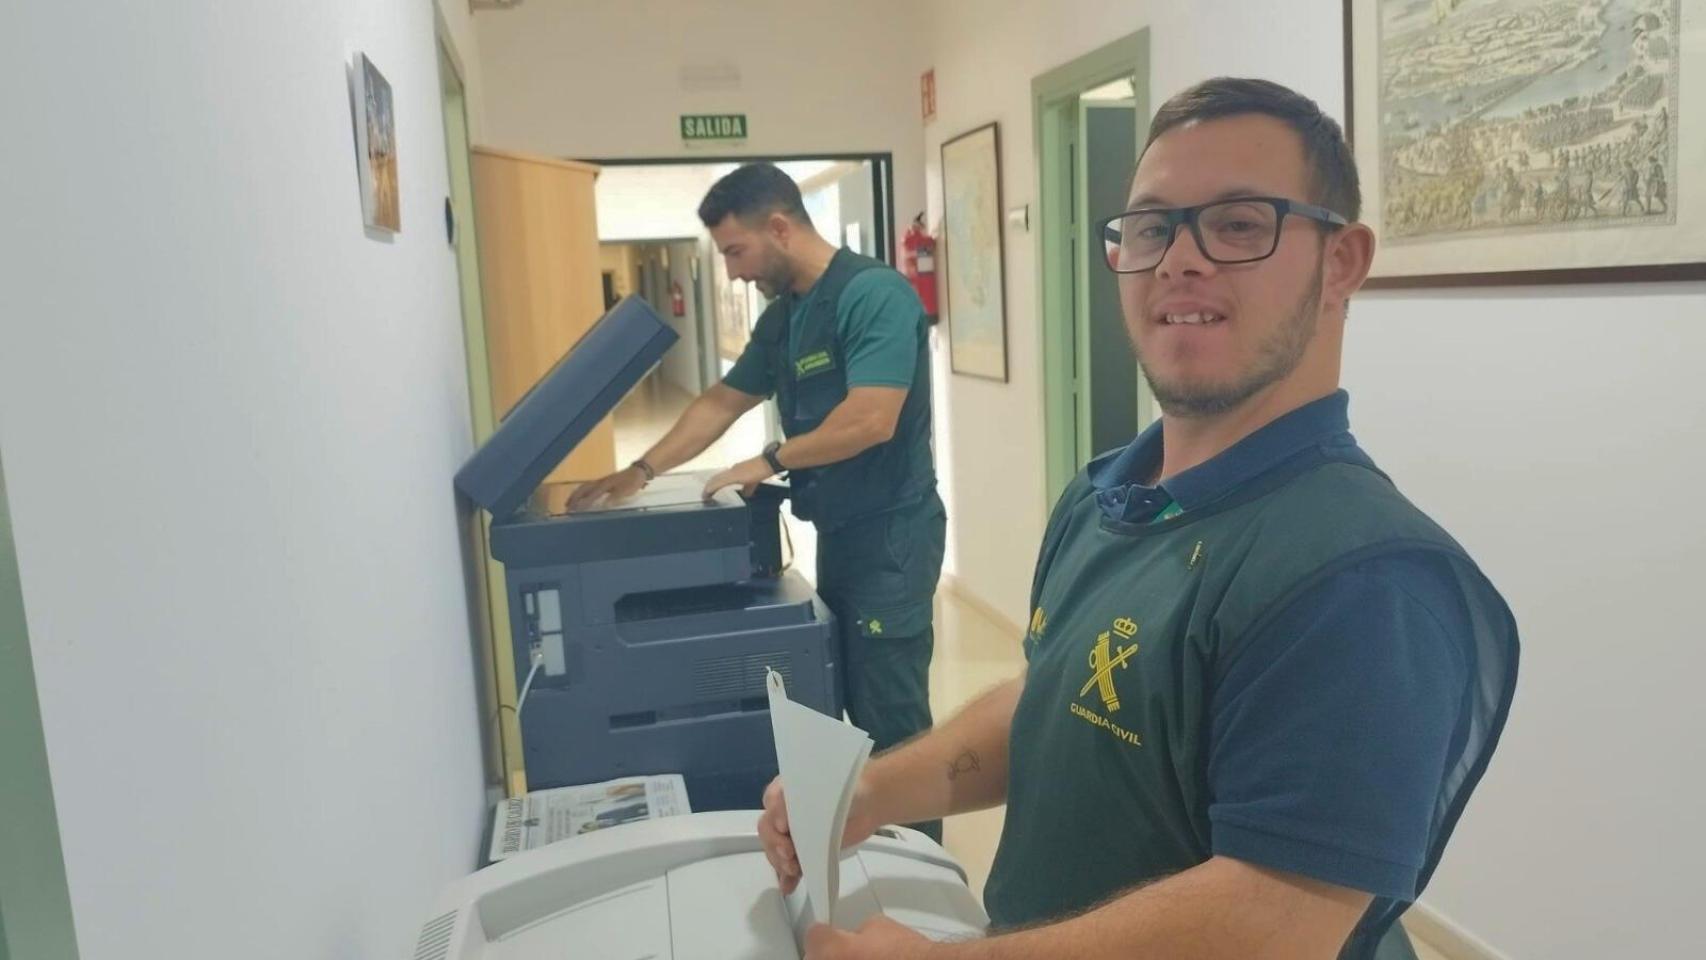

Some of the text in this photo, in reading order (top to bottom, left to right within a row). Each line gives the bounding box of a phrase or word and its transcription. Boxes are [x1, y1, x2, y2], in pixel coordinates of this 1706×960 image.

[684, 117, 743, 136] SALIDA
[1070, 702, 1142, 746] GUARDIA CIVIL
